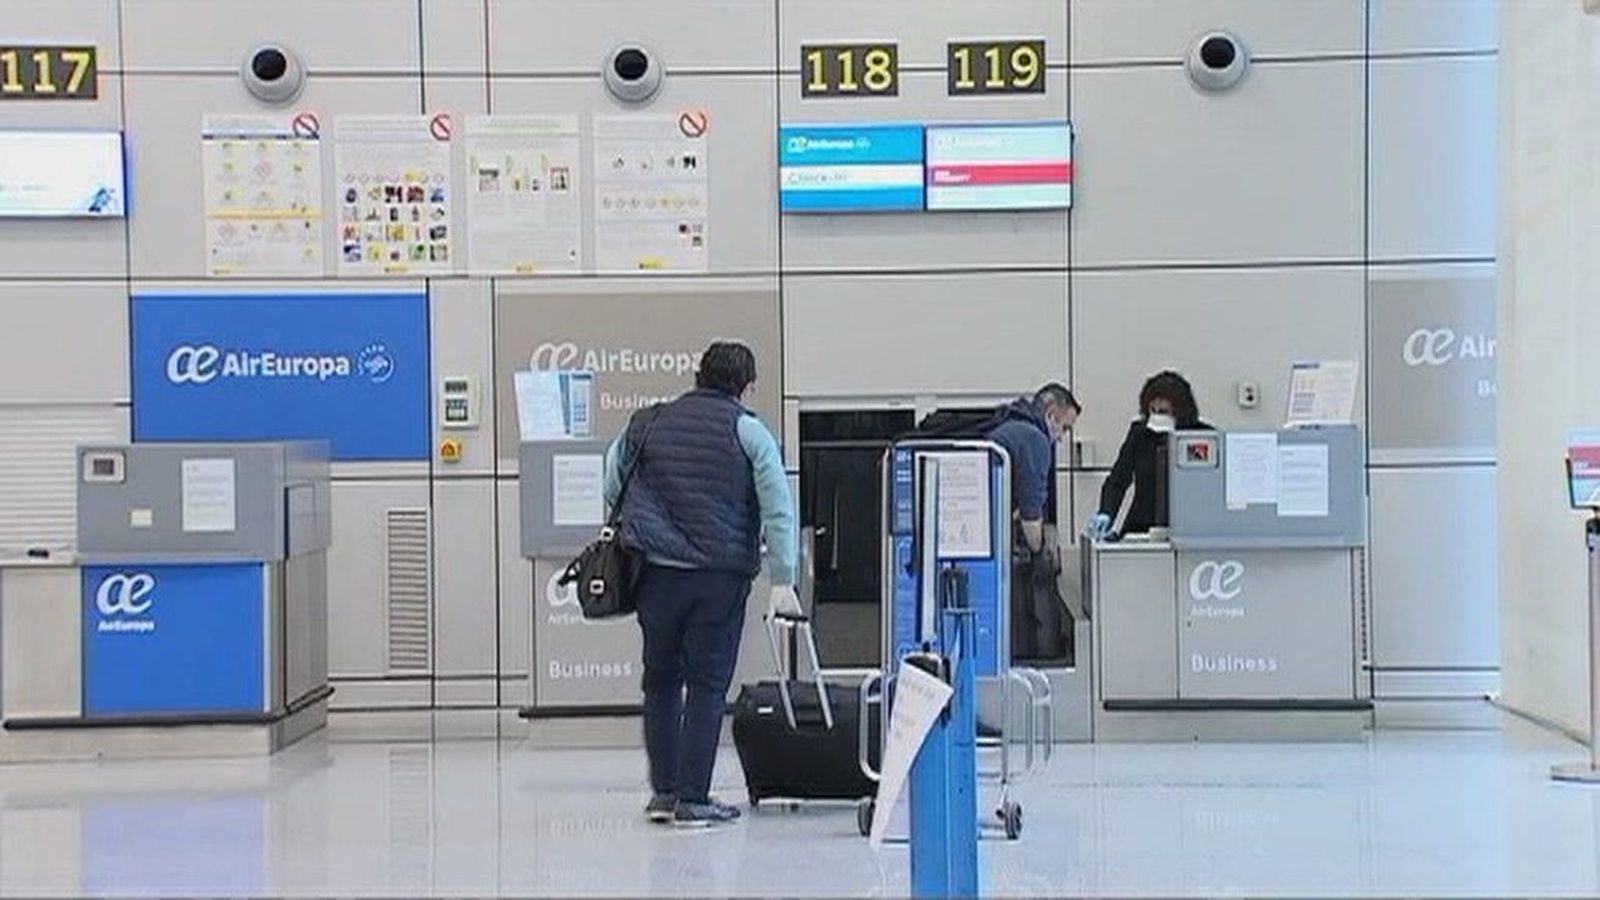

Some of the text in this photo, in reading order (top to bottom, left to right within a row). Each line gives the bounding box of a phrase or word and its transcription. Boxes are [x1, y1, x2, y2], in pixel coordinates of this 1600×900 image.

[1, 51, 93, 94] 117
[807, 49, 893, 92] 118
[953, 46, 1040, 88] 119
[222, 350, 350, 381] AirEuropa
[549, 660, 633, 680] Business
[1190, 653, 1278, 673] Business
